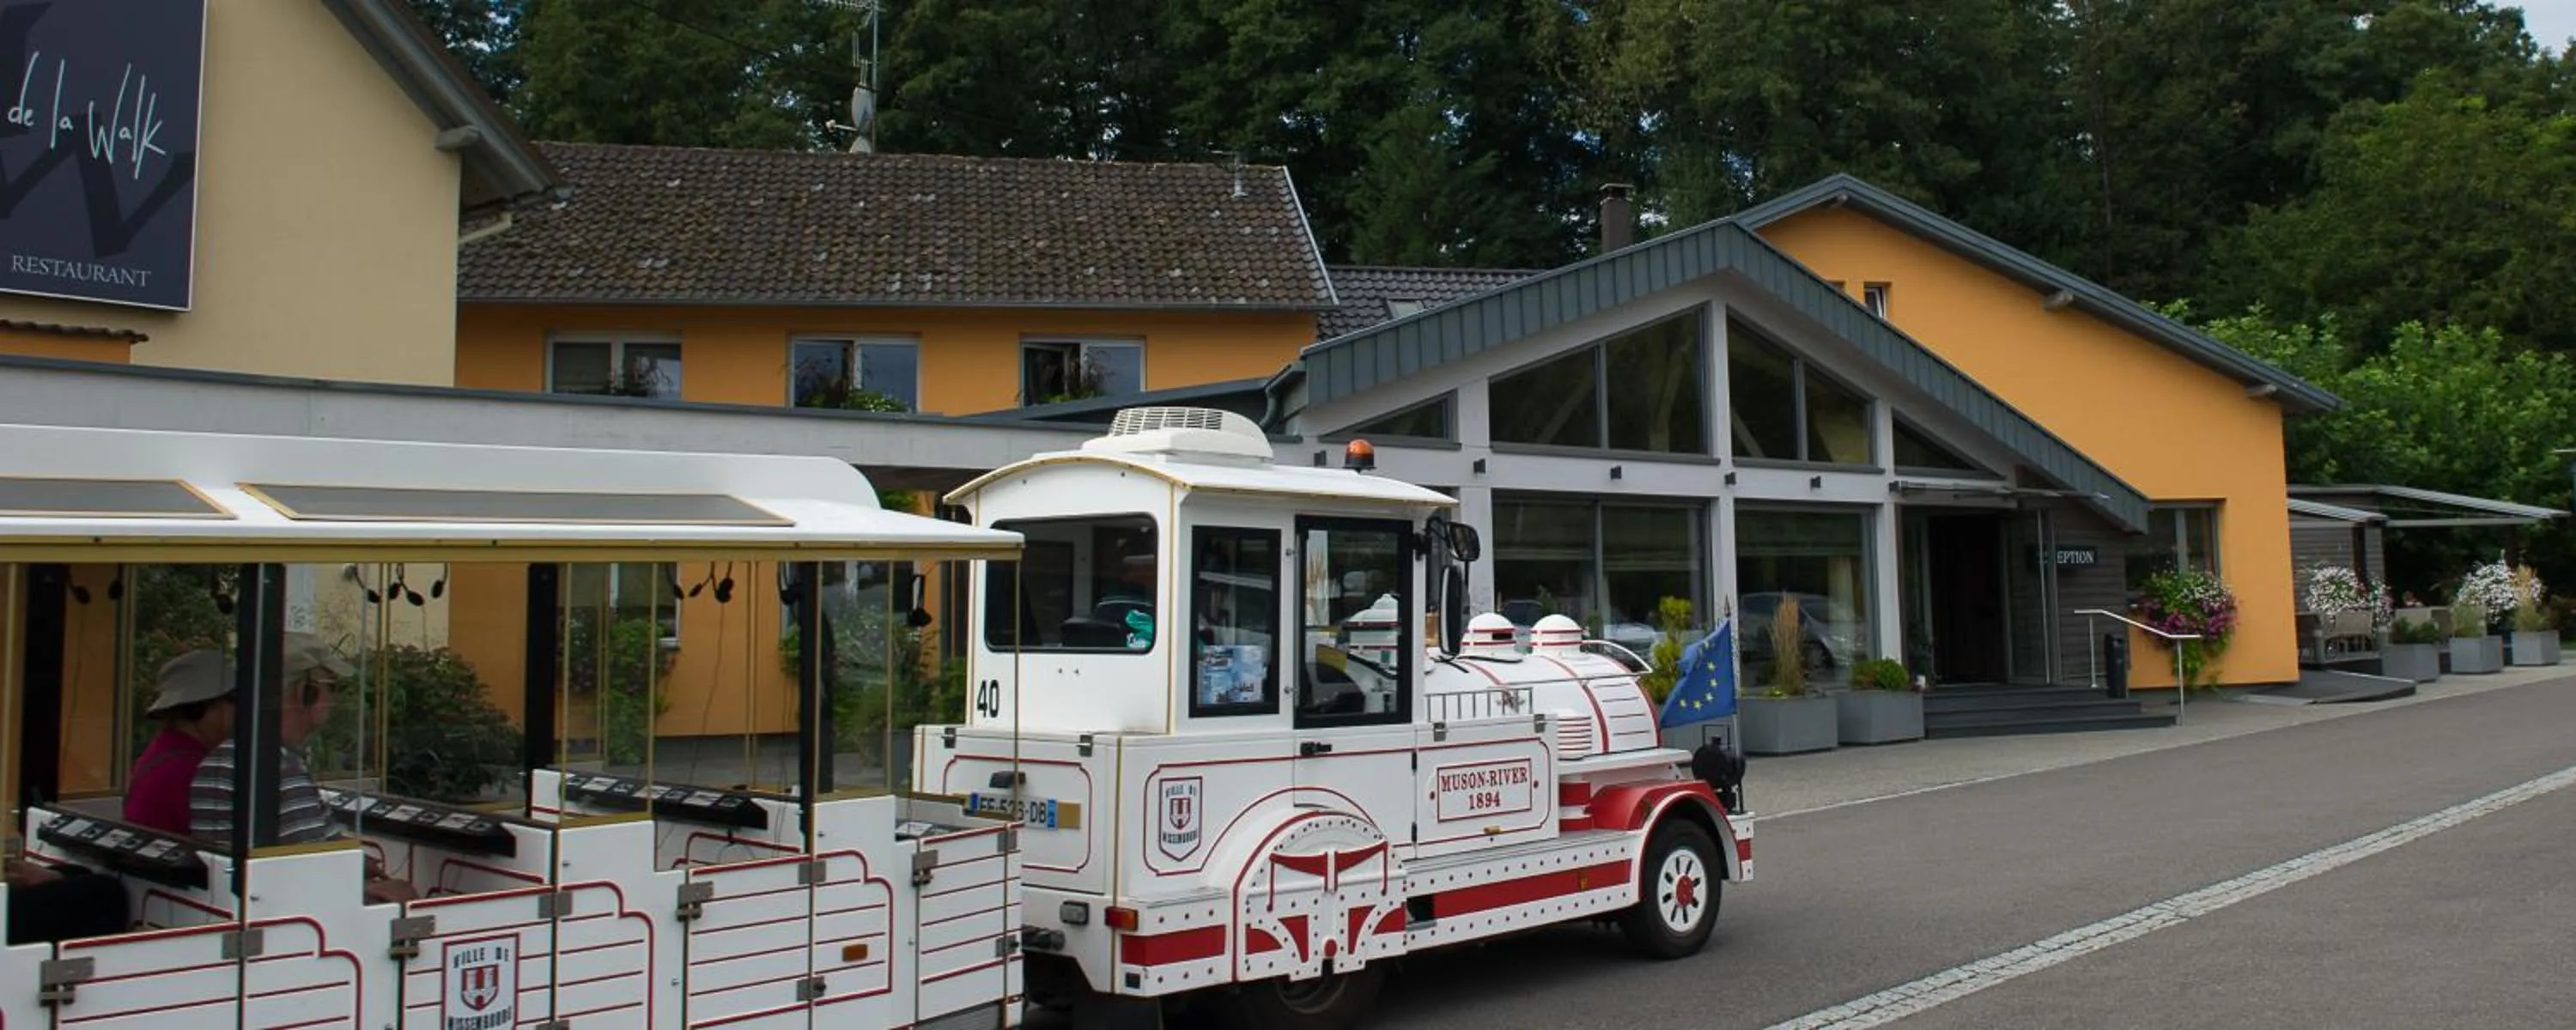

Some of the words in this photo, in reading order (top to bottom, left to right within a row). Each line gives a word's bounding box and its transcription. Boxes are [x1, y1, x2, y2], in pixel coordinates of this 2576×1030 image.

[7, 51, 39, 127] de
[50, 58, 74, 149] la
[88, 62, 167, 179] Walk
[11, 254, 152, 288] RESTAURANT
[976, 679, 999, 718] 40
[1441, 767, 1528, 791] MUSON-RIVER
[1468, 791, 1501, 809] 1894
